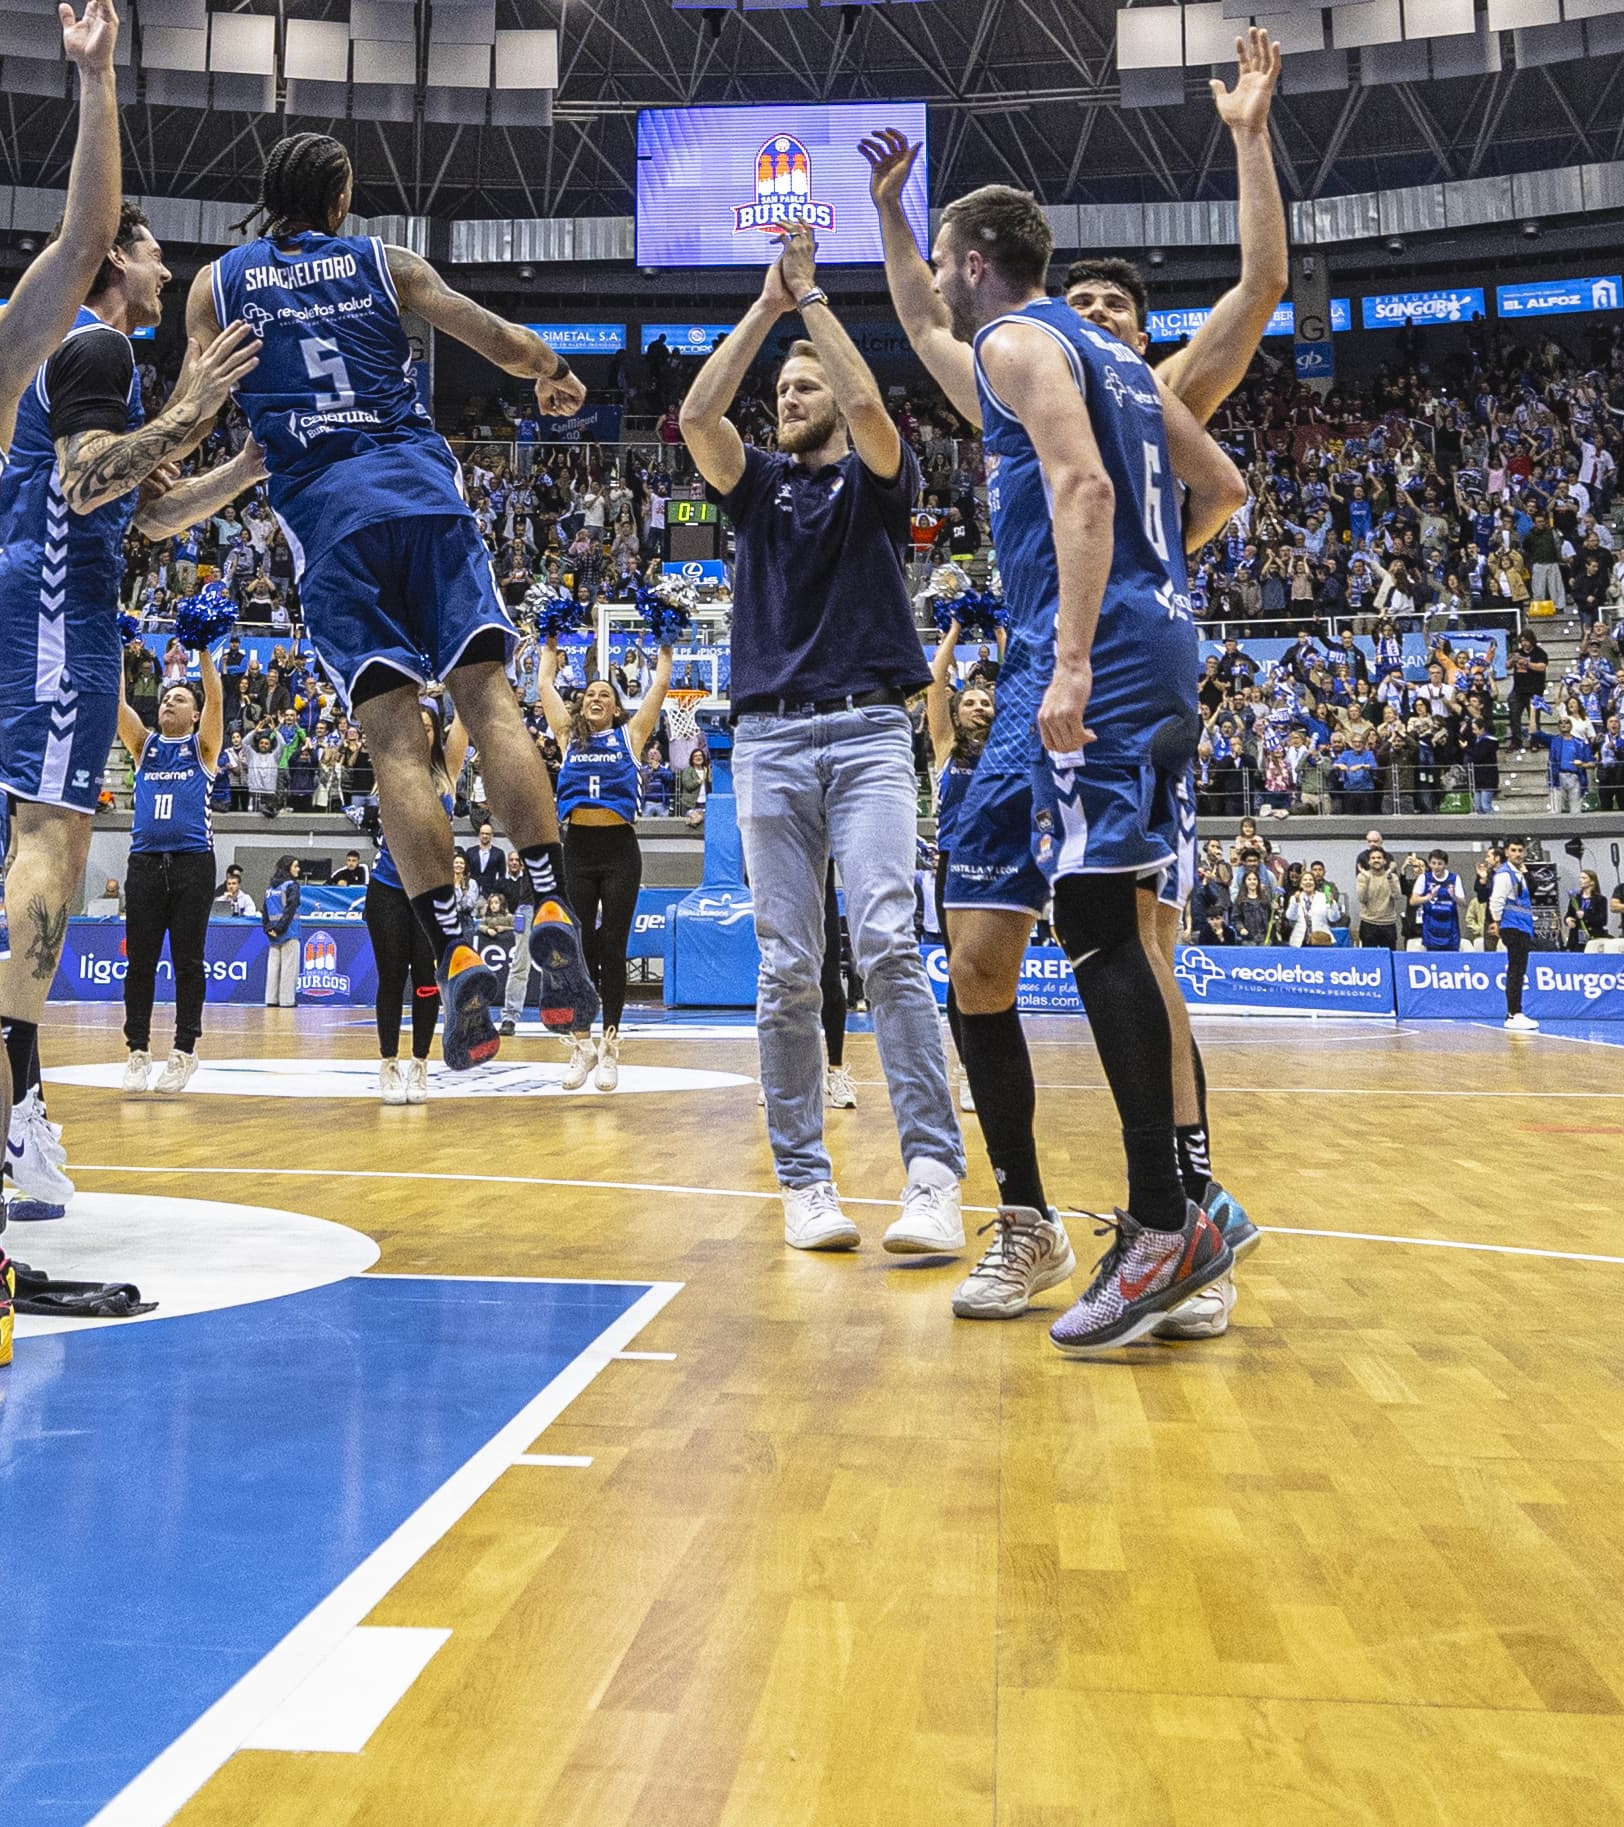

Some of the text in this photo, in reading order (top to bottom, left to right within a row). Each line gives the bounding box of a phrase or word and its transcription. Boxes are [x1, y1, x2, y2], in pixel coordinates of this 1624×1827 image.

[739, 203, 832, 228] BURGOS
[244, 253, 357, 291] SHACKELFORD
[337, 293, 373, 312] salud
[1503, 301, 1523, 311] EL
[1527, 294, 1582, 309] ALFOZ
[599, 330, 622, 342] S.A.
[1299, 315, 1324, 341] G
[298, 336, 356, 412] 5
[153, 793, 173, 820] 10
[1231, 962, 1382, 987] recoletas salud
[1408, 963, 1490, 991] Diario
[1535, 966, 1624, 999] Burgos
